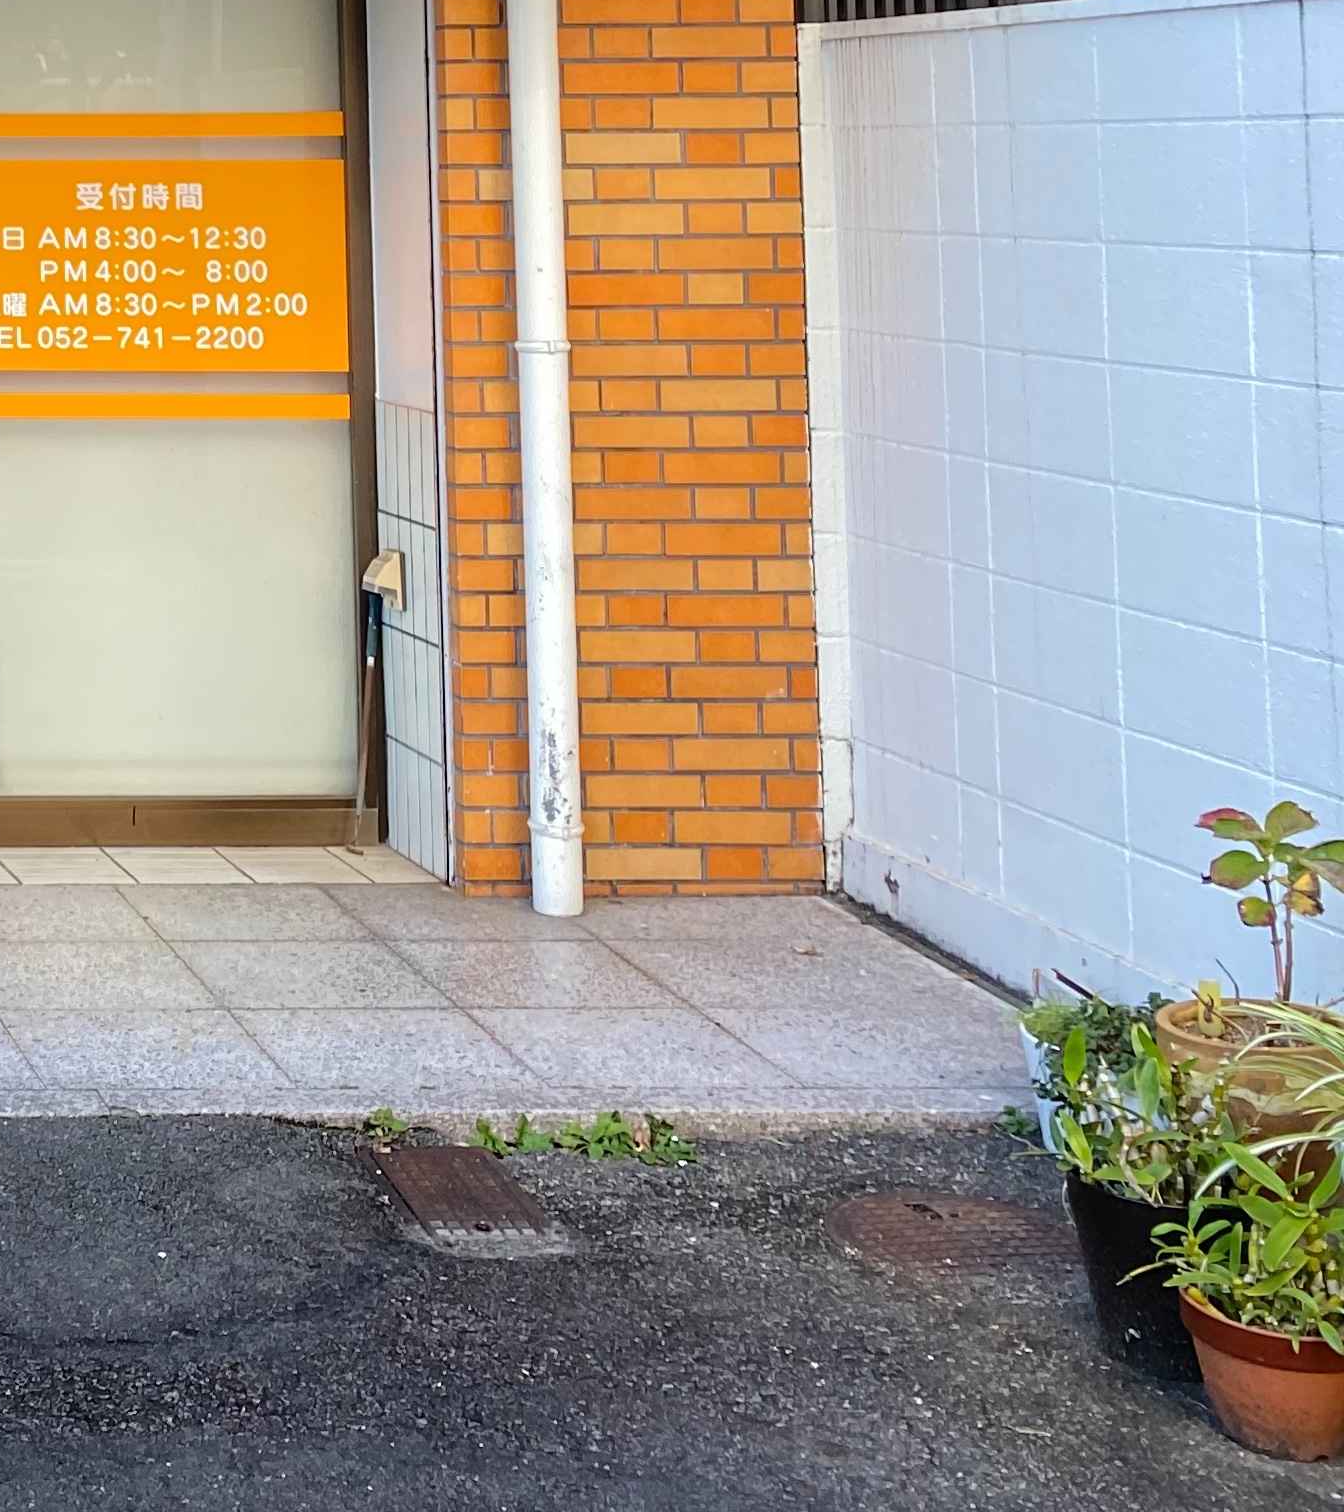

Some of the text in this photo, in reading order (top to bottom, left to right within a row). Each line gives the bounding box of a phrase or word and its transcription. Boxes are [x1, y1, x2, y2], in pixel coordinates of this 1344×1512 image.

[77, 183, 203, 210] 受付時間
[207, 260, 267, 282] 8:00
